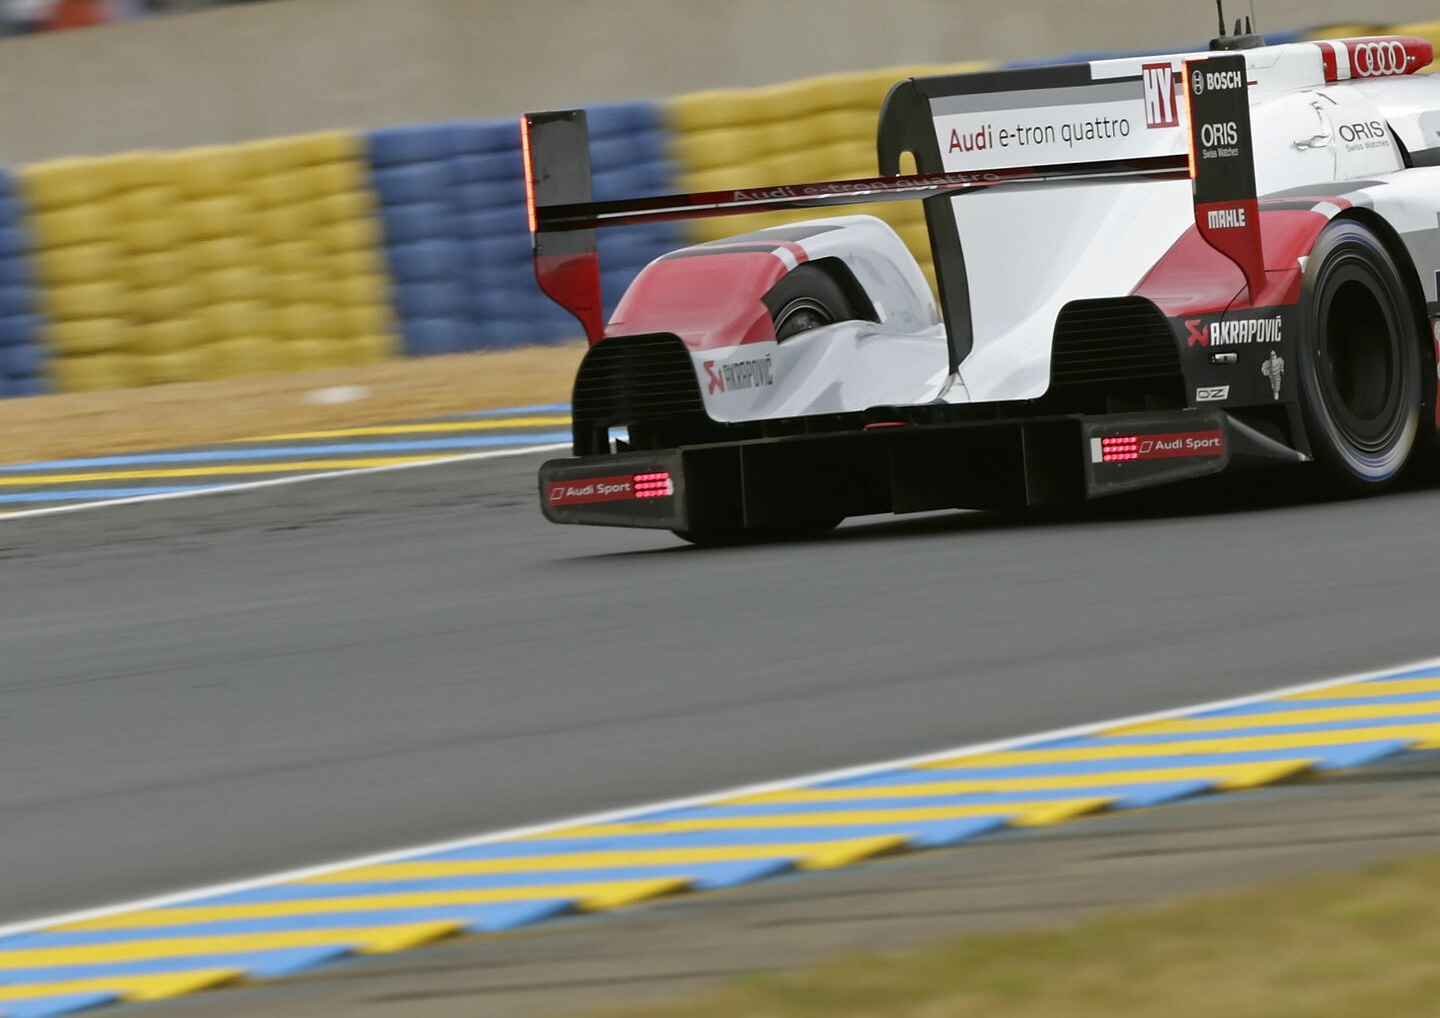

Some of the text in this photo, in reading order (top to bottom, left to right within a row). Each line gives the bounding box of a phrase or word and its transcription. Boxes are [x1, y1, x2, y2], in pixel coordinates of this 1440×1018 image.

[1207, 71, 1241, 90] BOSCH
[1143, 68, 1175, 125] HY
[949, 116, 1130, 153] Audi e-tron quattro
[1201, 122, 1238, 147] ORIS
[1339, 121, 1384, 142] ORIS
[1203, 148, 1238, 159] Swiss Watches
[733, 171, 1000, 203] Audi e-tron quattro
[1208, 208, 1246, 229] MAHLE
[1198, 388, 1225, 399] OZ
[1155, 437, 1220, 451] Audi Sport
[566, 482, 631, 497] Audi Sport
